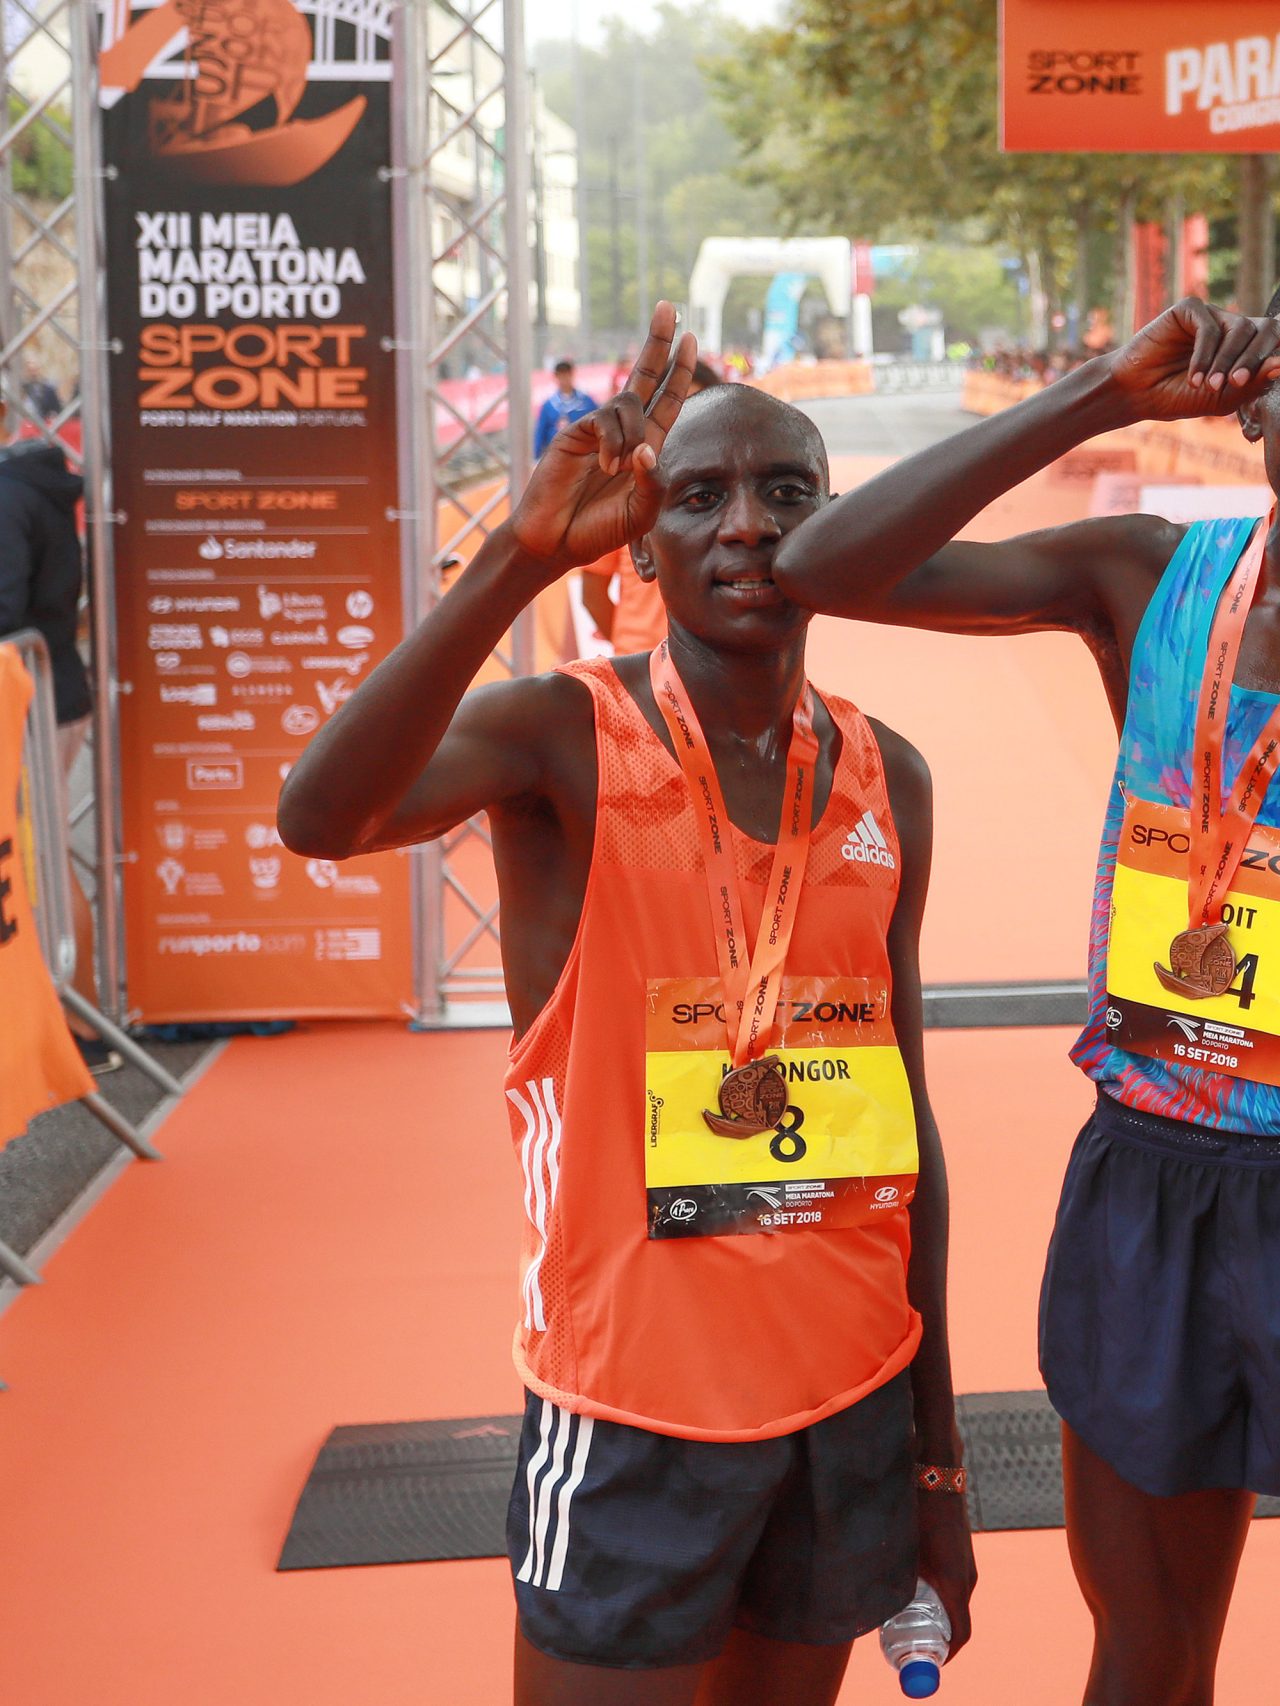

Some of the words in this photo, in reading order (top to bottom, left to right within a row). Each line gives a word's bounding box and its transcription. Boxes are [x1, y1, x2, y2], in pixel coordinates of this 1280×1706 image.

[1027, 50, 1142, 72] SPORT
[1028, 74, 1142, 95] ZONE
[137, 212, 192, 249] XII
[200, 213, 299, 249] MEIA
[138, 248, 366, 284] MARATONA
[140, 283, 197, 318] DO
[205, 284, 341, 318] PORTO
[139, 324, 366, 367] SPORT
[138, 366, 368, 409] ZONE
[140, 411, 186, 427] PORTO
[224, 411, 297, 426] MARATHON
[175, 491, 253, 510] SPORT
[256, 491, 338, 510] ZONE
[1215, 641, 1228, 679] SPORT
[1208, 680, 1221, 720] ZONE
[676, 713, 695, 750] ZONE
[1239, 777, 1256, 812] SPORT
[1254, 740, 1278, 776] ZONE
[699, 776, 716, 812] SPORT
[708, 814, 722, 855] ZONE
[1202, 794, 1210, 834] ZONE
[841, 842, 895, 870] adidas
[1131, 824, 1190, 854] SPO
[1202, 882, 1218, 918] SPORT
[1215, 841, 1233, 880] ZONE
[720, 886, 733, 926] SPORT
[769, 907, 784, 946] SPORT
[778, 865, 792, 905] ZONE
[1220, 903, 1258, 930] OIT
[726, 927, 738, 969] ZONE
[671, 1002, 785, 1024] SPT
[792, 1002, 875, 1024] ZONE
[755, 975, 769, 1016] ZONE
[1173, 1043, 1185, 1056] 16
[1187, 1046, 1210, 1062] SET
[1210, 1050, 1238, 1069] 2018
[1203, 1031, 1219, 1042] MEIA
[1219, 1034, 1254, 1048] MARATONA
[650, 1104, 658, 1148] LIDERGRAF
[769, 1104, 807, 1162] 8
[785, 1192, 801, 1200] MEIA
[802, 1190, 835, 1199] MARATONA
[870, 1202, 900, 1210] HYUNDAI
[758, 1214, 772, 1227] 16
[773, 1212, 796, 1226] SET
[796, 1212, 822, 1224] 2018
